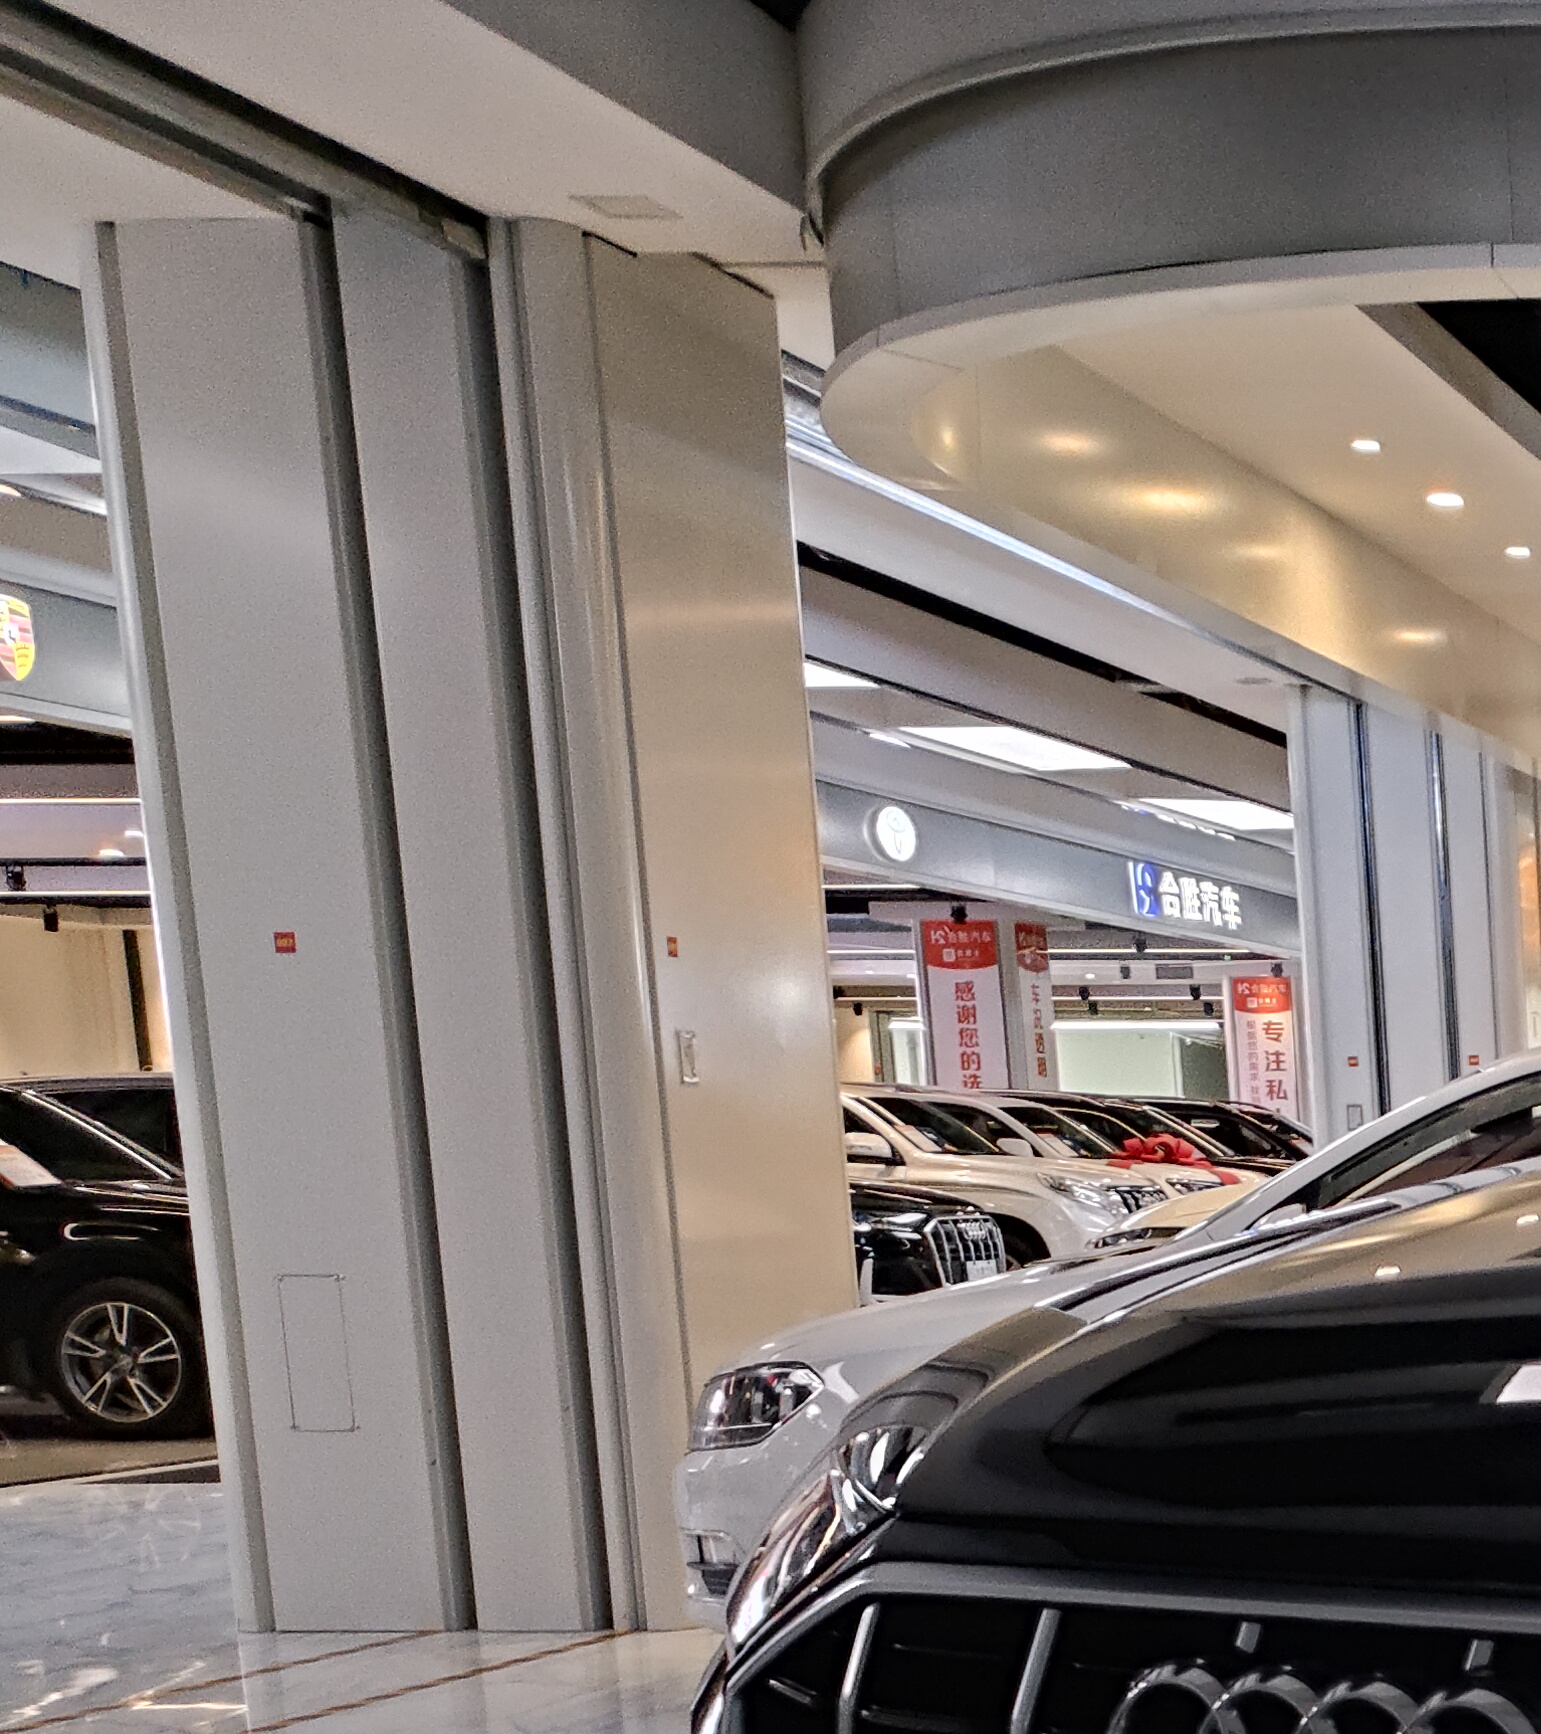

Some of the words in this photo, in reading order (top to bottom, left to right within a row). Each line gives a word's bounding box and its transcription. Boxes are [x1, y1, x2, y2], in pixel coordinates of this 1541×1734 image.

[1159, 871, 1242, 931] 合胜汽车
[1261, 1019, 1289, 1114] 专注私
